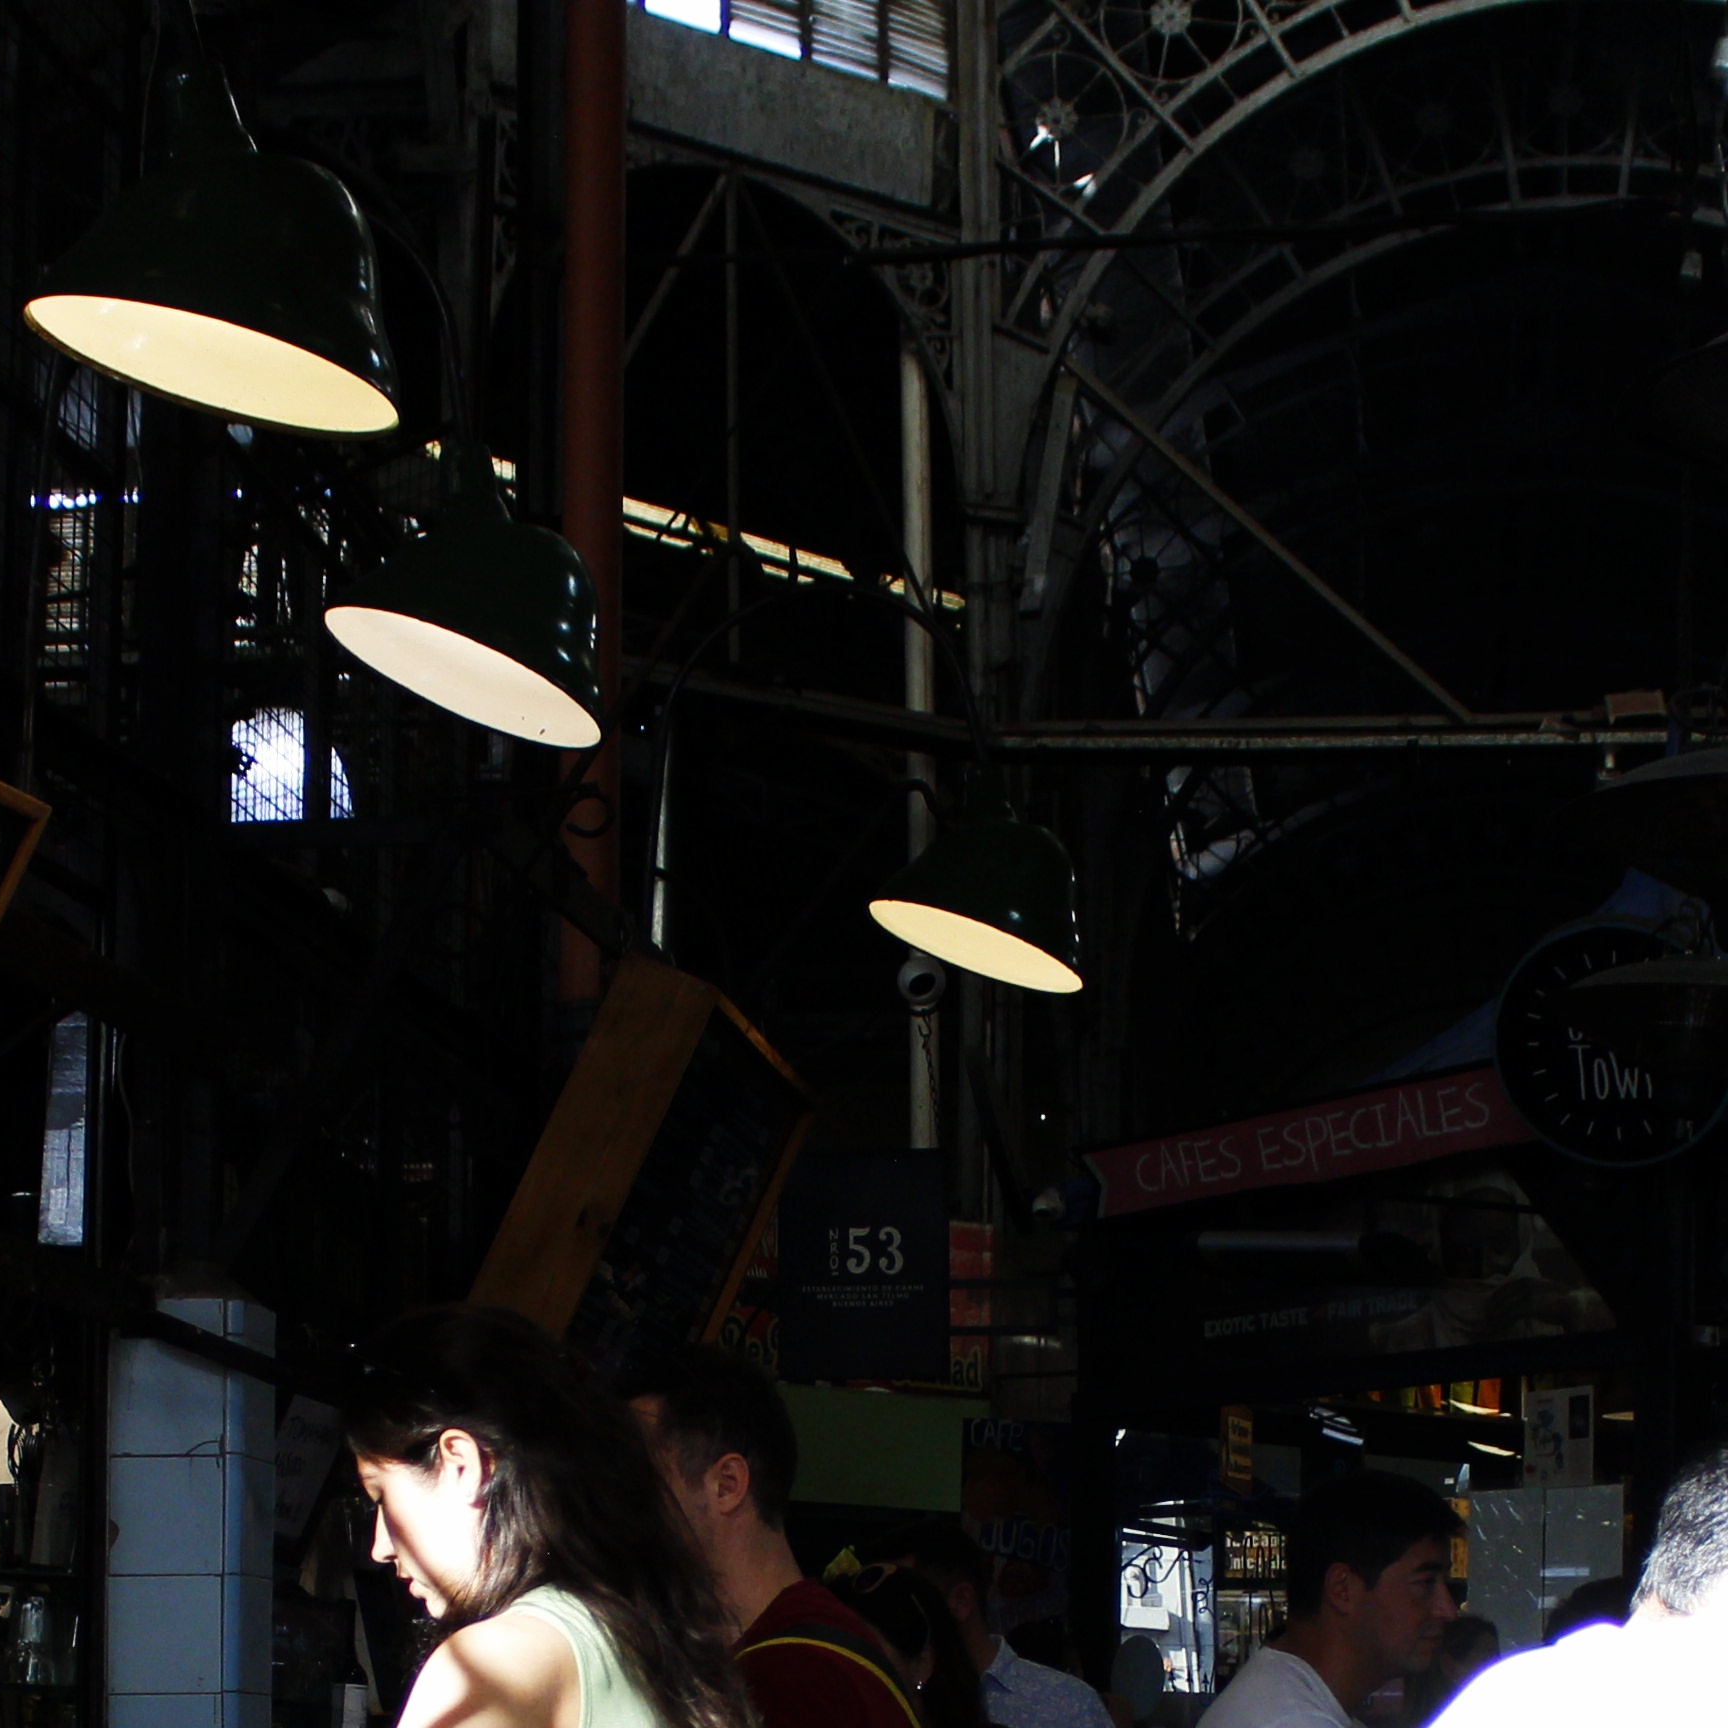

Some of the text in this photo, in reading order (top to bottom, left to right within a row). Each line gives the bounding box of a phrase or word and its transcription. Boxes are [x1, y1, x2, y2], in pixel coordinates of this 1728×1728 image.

[1135, 1080, 1491, 1193] CAFES ESPECIALES
[845, 1225, 904, 1275] 53
